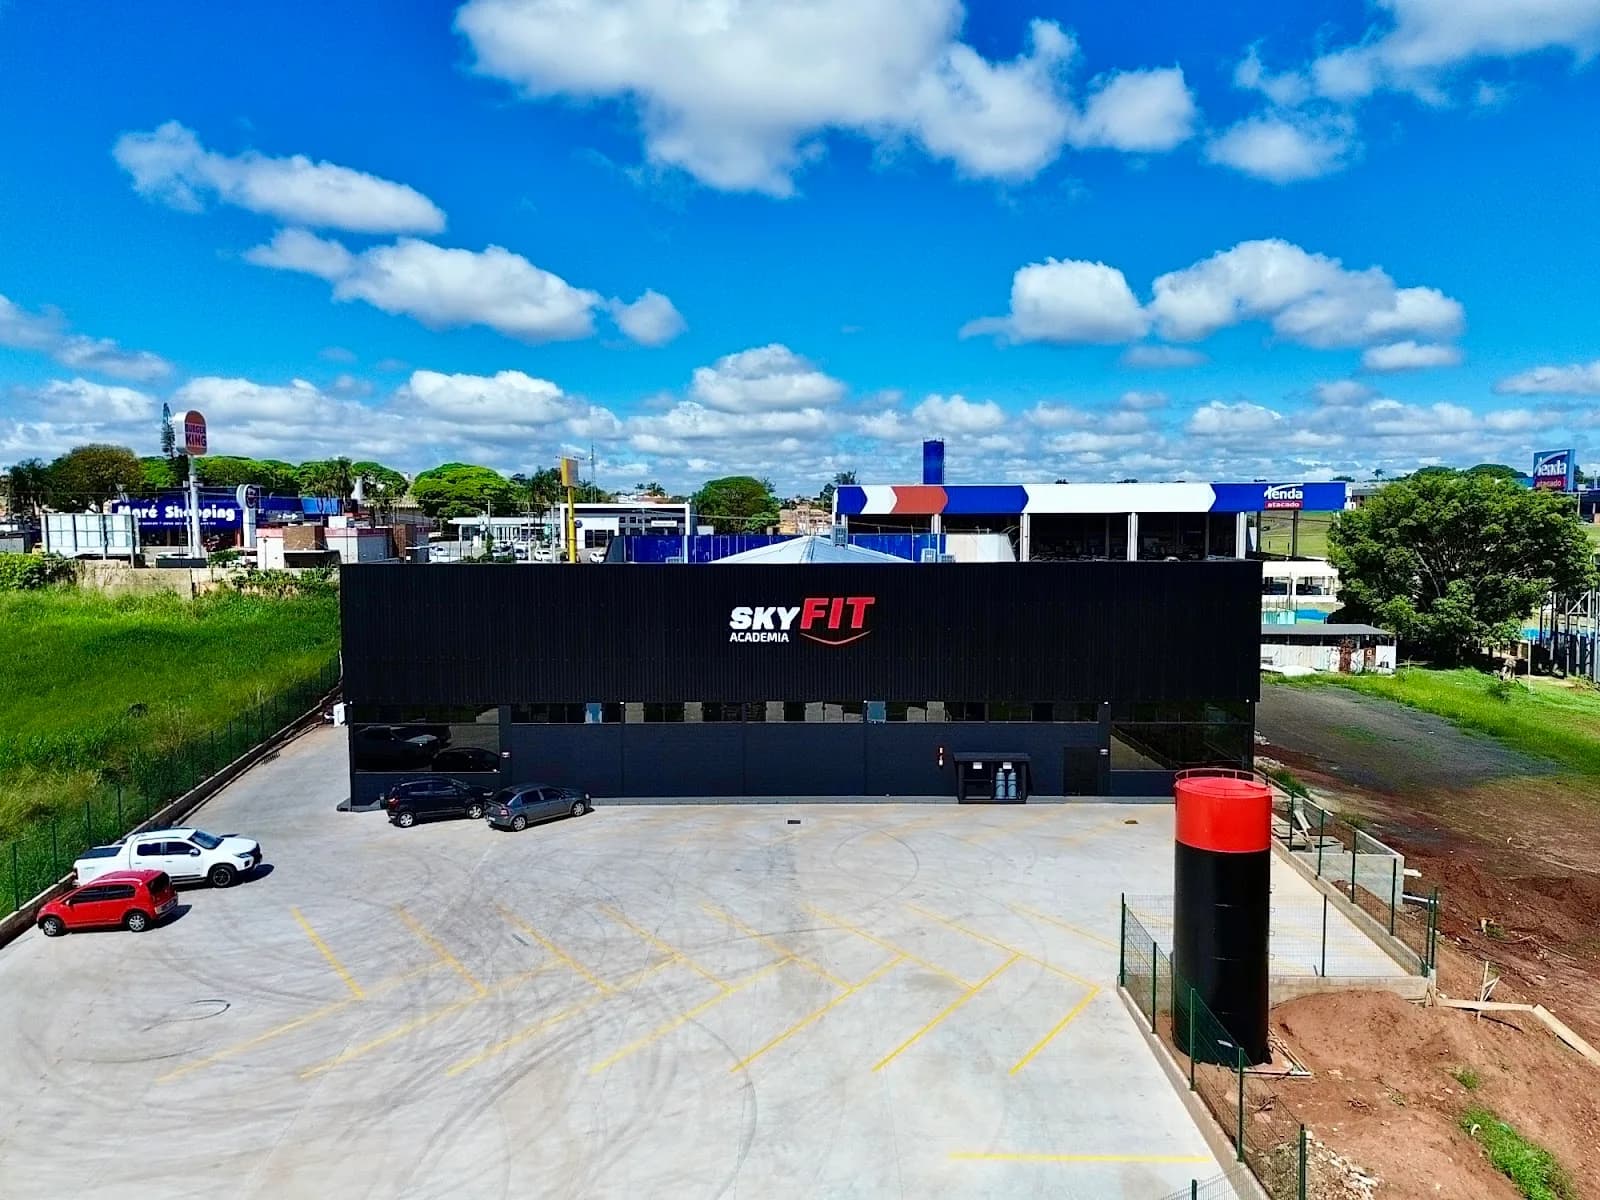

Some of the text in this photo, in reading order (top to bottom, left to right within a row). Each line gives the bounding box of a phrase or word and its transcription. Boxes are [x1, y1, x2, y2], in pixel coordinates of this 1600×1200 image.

[185, 433, 207, 447] KING
[117, 504, 158, 519] Maré
[729, 631, 790, 643] ACADEMIA
